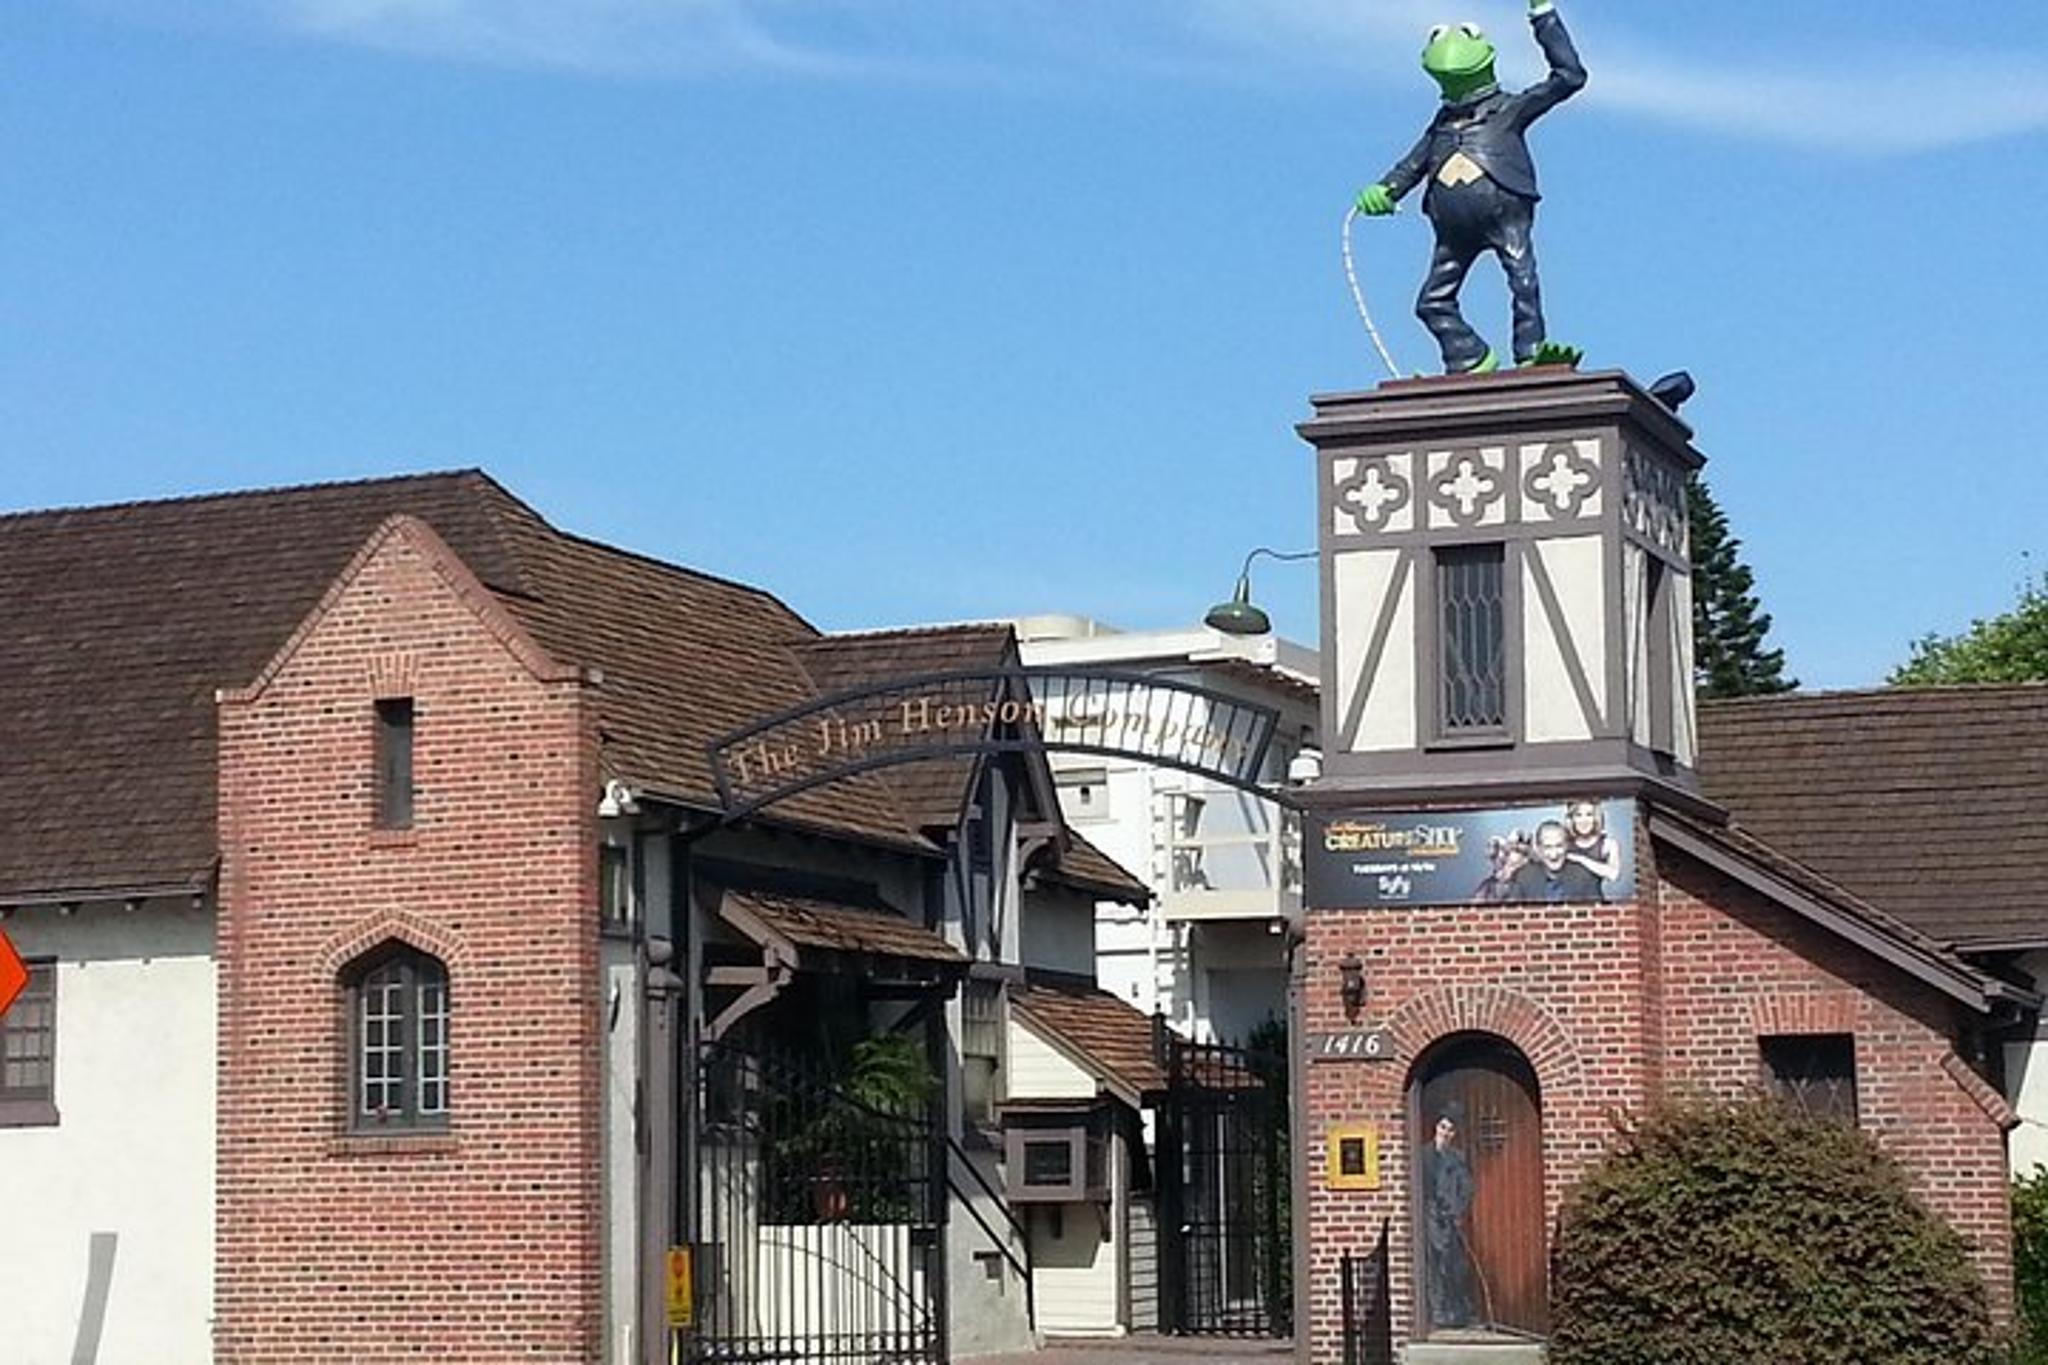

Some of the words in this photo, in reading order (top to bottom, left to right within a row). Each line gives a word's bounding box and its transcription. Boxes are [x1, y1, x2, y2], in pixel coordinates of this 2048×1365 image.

[730, 743, 799, 783] The
[819, 716, 882, 755] Jim
[900, 696, 1046, 734] Henson
[1324, 1034, 1381, 1054] 1416
